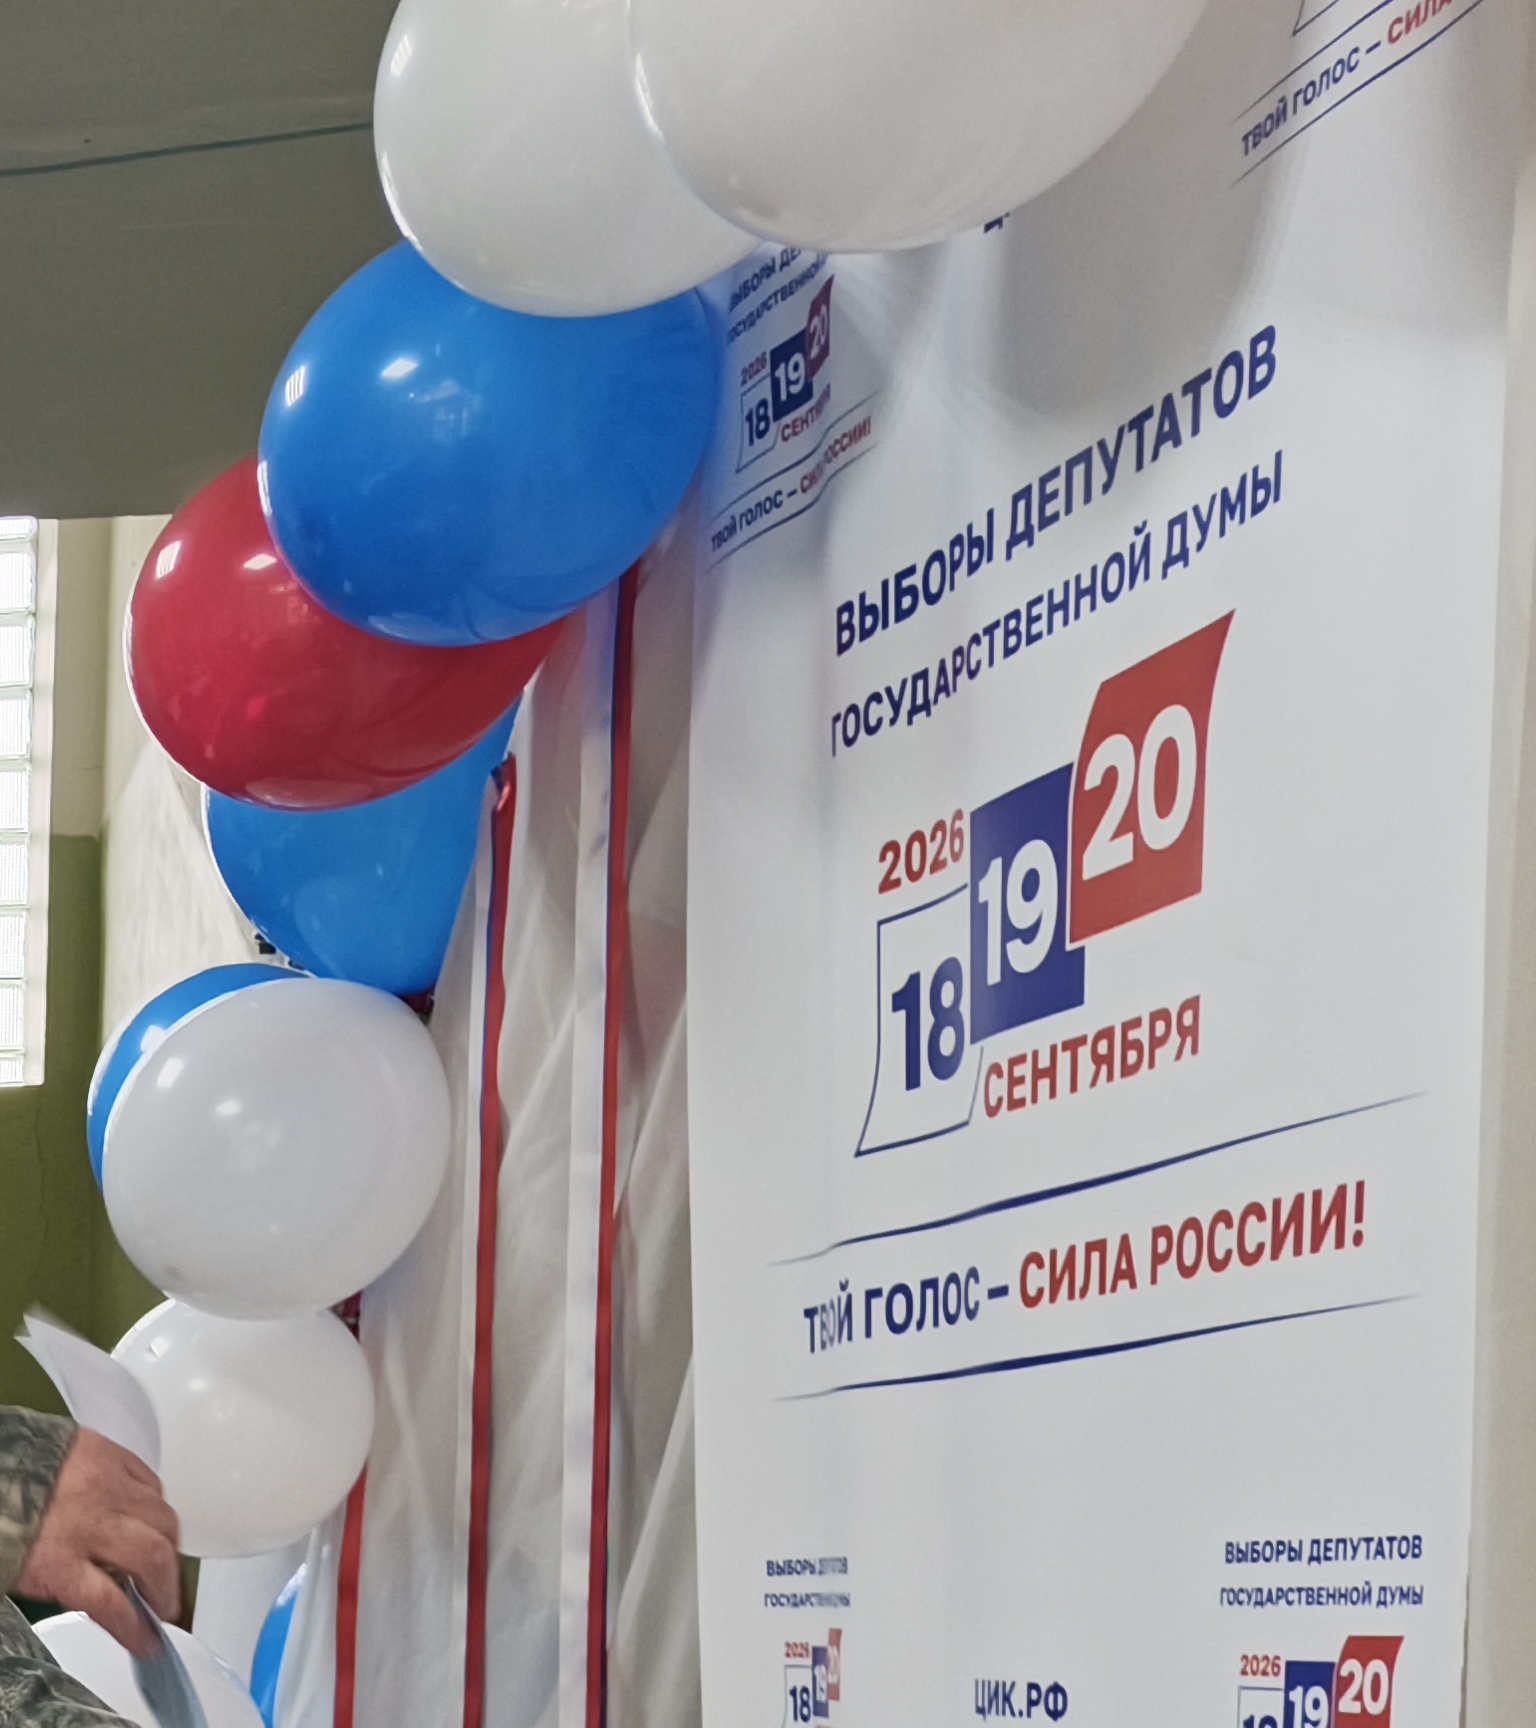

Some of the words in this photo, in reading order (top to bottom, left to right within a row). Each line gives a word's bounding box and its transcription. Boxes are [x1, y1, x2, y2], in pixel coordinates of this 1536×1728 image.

[1242, 97, 1287, 156] ТВОЙ
[1293, 47, 1360, 115] ГОЛОС
[746, 397, 770, 446] 18
[775, 352, 805, 401] 19
[810, 304, 827, 358] 20
[712, 515, 737, 552] ТВОЙ
[739, 490, 783, 531] ГОЛОС
[825, 416, 871, 464] ОССИИ!
[836, 509, 994, 656] ВЫБОРЫ
[1005, 324, 1277, 560] ДЕПУТАТОВ
[832, 521, 1152, 756] ГОСУДАРСТВЕННОЙ
[1161, 450, 1282, 582] ДУМЫ
[878, 809, 964, 894] 2026
[891, 956, 964, 1091] 18
[977, 839, 1058, 985] 19
[1082, 704, 1197, 880] 20
[983, 994, 1201, 1118] СЕНТЯБРЯ
[803, 1278, 853, 1353] ТВОЙ
[863, 1266, 980, 1339] ГОЛОС
[1019, 1233, 1138, 1309] СИЛА
[1150, 1179, 1366, 1286] РОССИИ!
[1220, 1581, 1372, 1608] ГОСУДАРСТВЕННОЙ
[1376, 1584, 1424, 1608] ДУМЫ
[1225, 1540, 1302, 1564] ВЫБОРЫ
[1308, 1535, 1423, 1565] ДЕПУТАТОВ
[789, 1685, 811, 1722] 18
[974, 1679, 1068, 1721] ЦИК.РФ
[1240, 1655, 1281, 1677] 2026
[1338, 1659, 1389, 1715] 20
